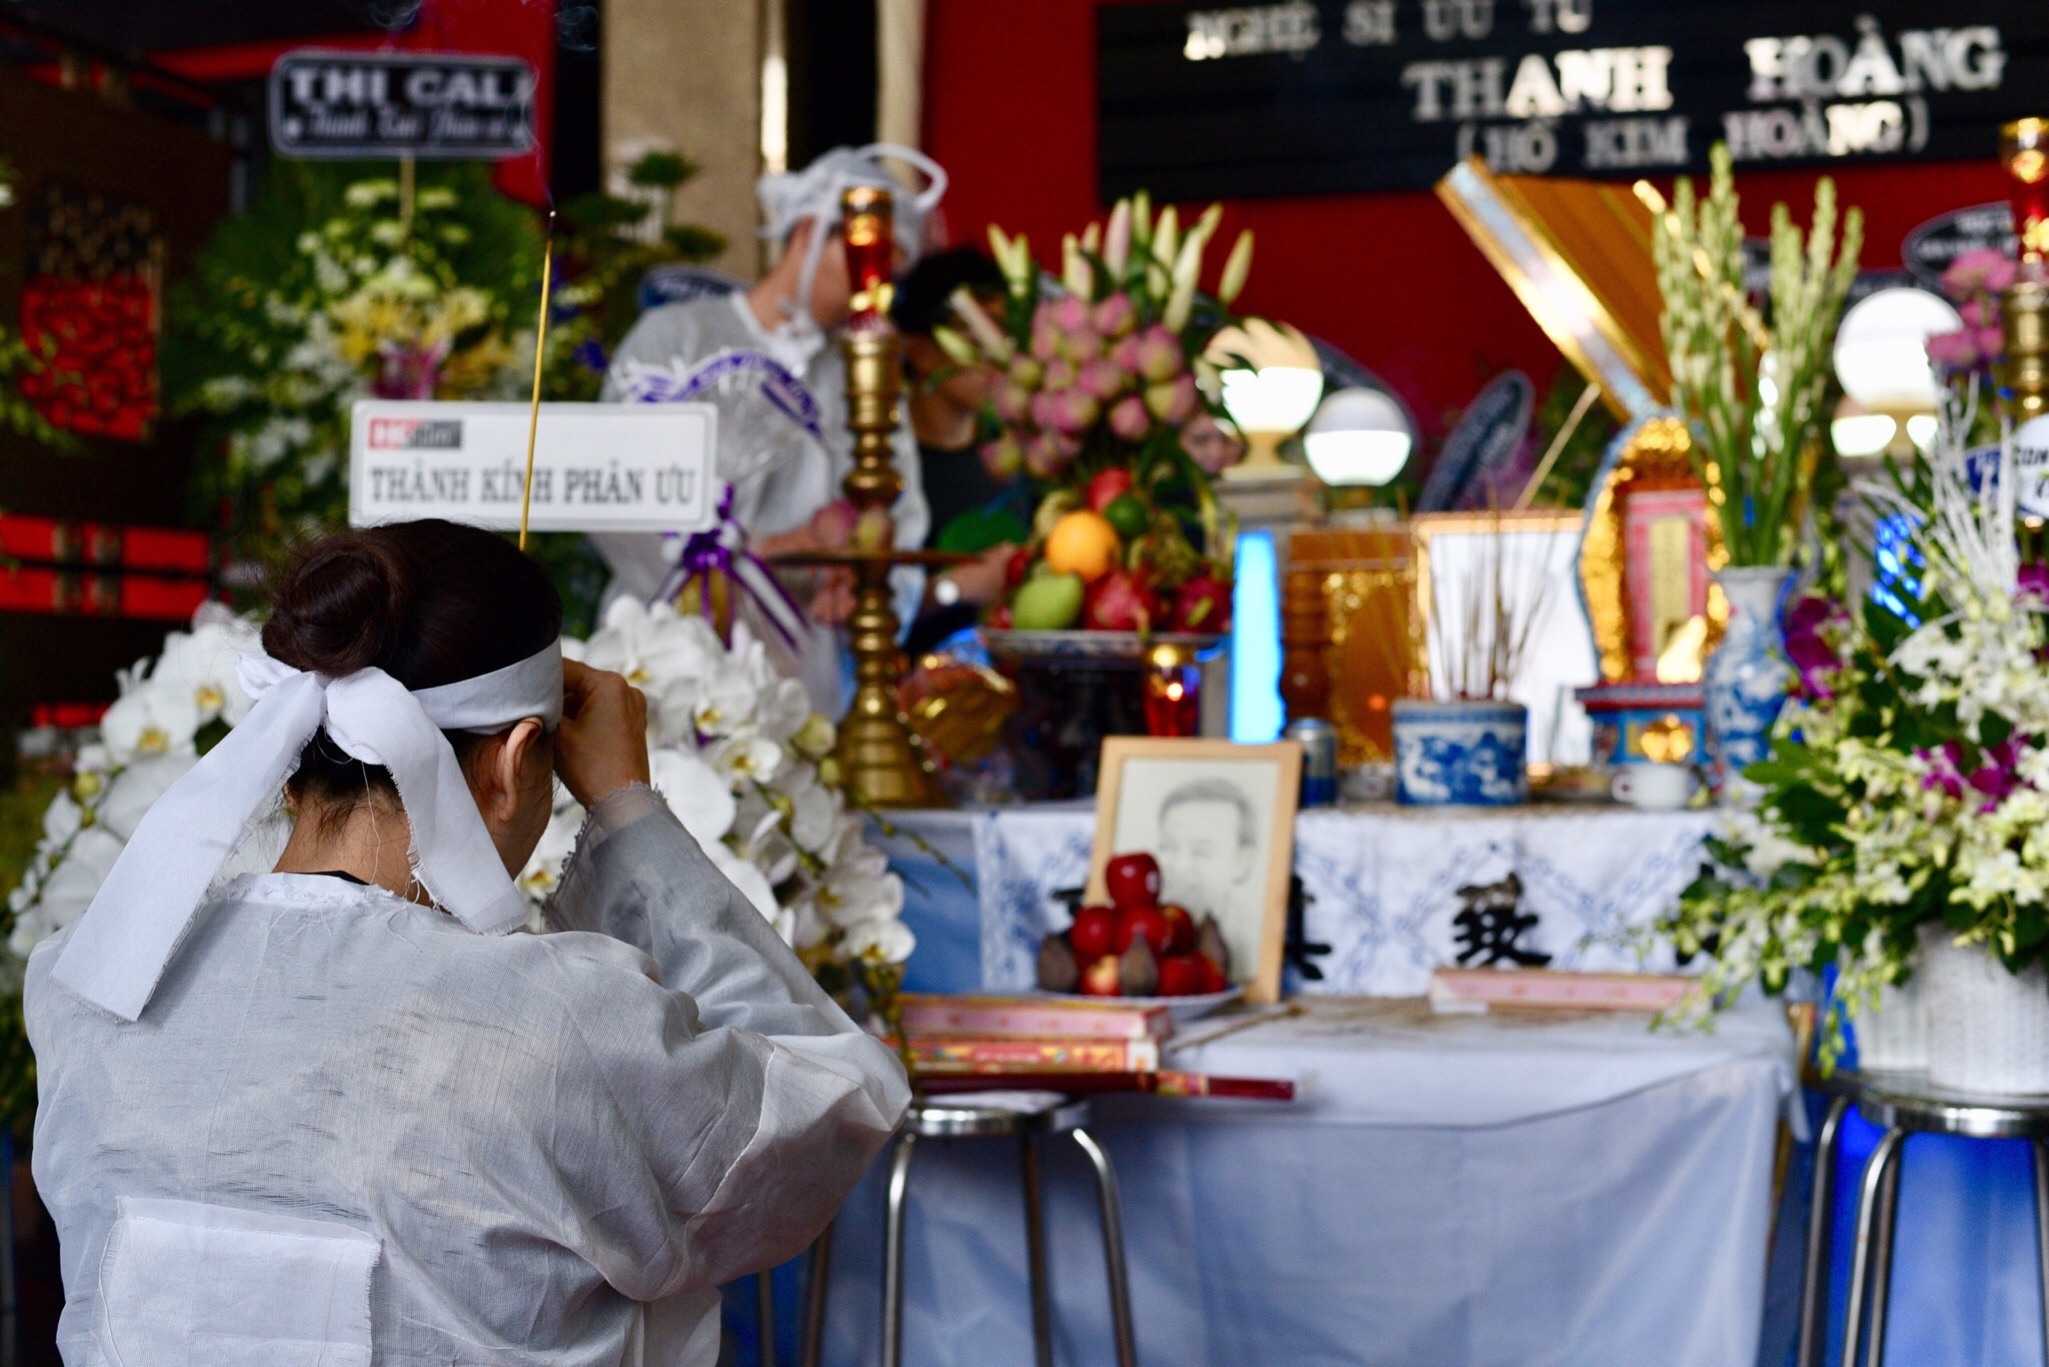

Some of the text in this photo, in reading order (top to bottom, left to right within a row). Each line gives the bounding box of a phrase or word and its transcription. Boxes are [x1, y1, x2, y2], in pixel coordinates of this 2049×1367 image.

[1402, 14, 2004, 120] THANH HOÀNG
[1583, 117, 1687, 167] KIM
[370, 458, 697, 504] THÀNH KÍNH PHÂN ƯU
